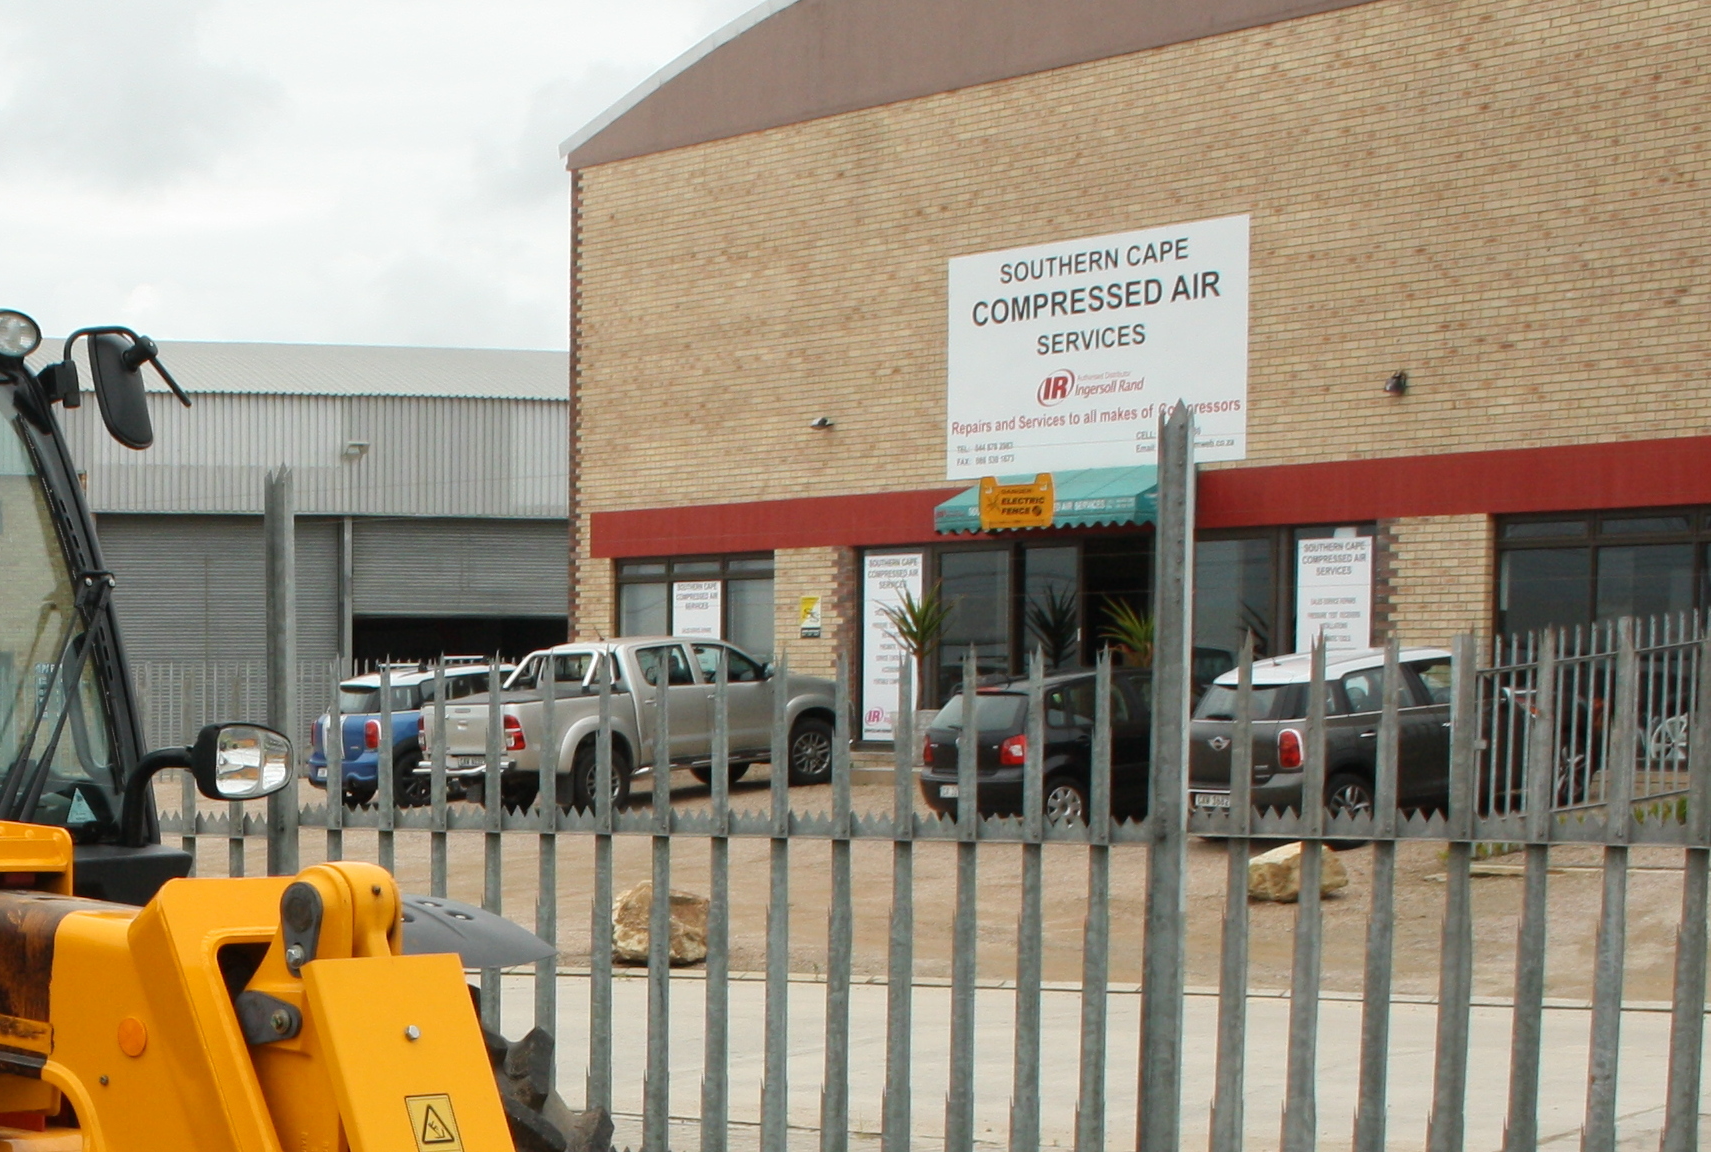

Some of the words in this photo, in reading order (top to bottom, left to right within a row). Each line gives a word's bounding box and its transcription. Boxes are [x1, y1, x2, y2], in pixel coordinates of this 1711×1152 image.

[1000, 248, 1119, 284] SOUTHERN
[1126, 237, 1189, 267] CAPE
[972, 278, 1163, 326] COMPRESSED
[1171, 270, 1220, 302] AIR
[1036, 323, 1146, 355] SERVICES
[1043, 376, 1069, 400] IR
[1075, 379, 1117, 398] Ingersoll
[1118, 376, 1144, 392] Rand
[952, 420, 992, 437] Repairs
[995, 416, 1015, 431] and
[1019, 413, 1065, 429] Services
[1069, 411, 1080, 425] to
[1083, 408, 1097, 423] all
[1100, 406, 1137, 422] makes
[1141, 404, 1153, 418] of
[1158, 399, 1241, 416] Copressors
[1001, 496, 1044, 506] ELECTRIC
[1001, 507, 1031, 515] FENCE
[1303, 542, 1343, 552] SOUTHERN
[1345, 541, 1367, 551] CAPE
[1302, 554, 1352, 564] COMPRESSED
[1354, 553, 1366, 562] AIR
[1316, 565, 1352, 576] SERVICES
